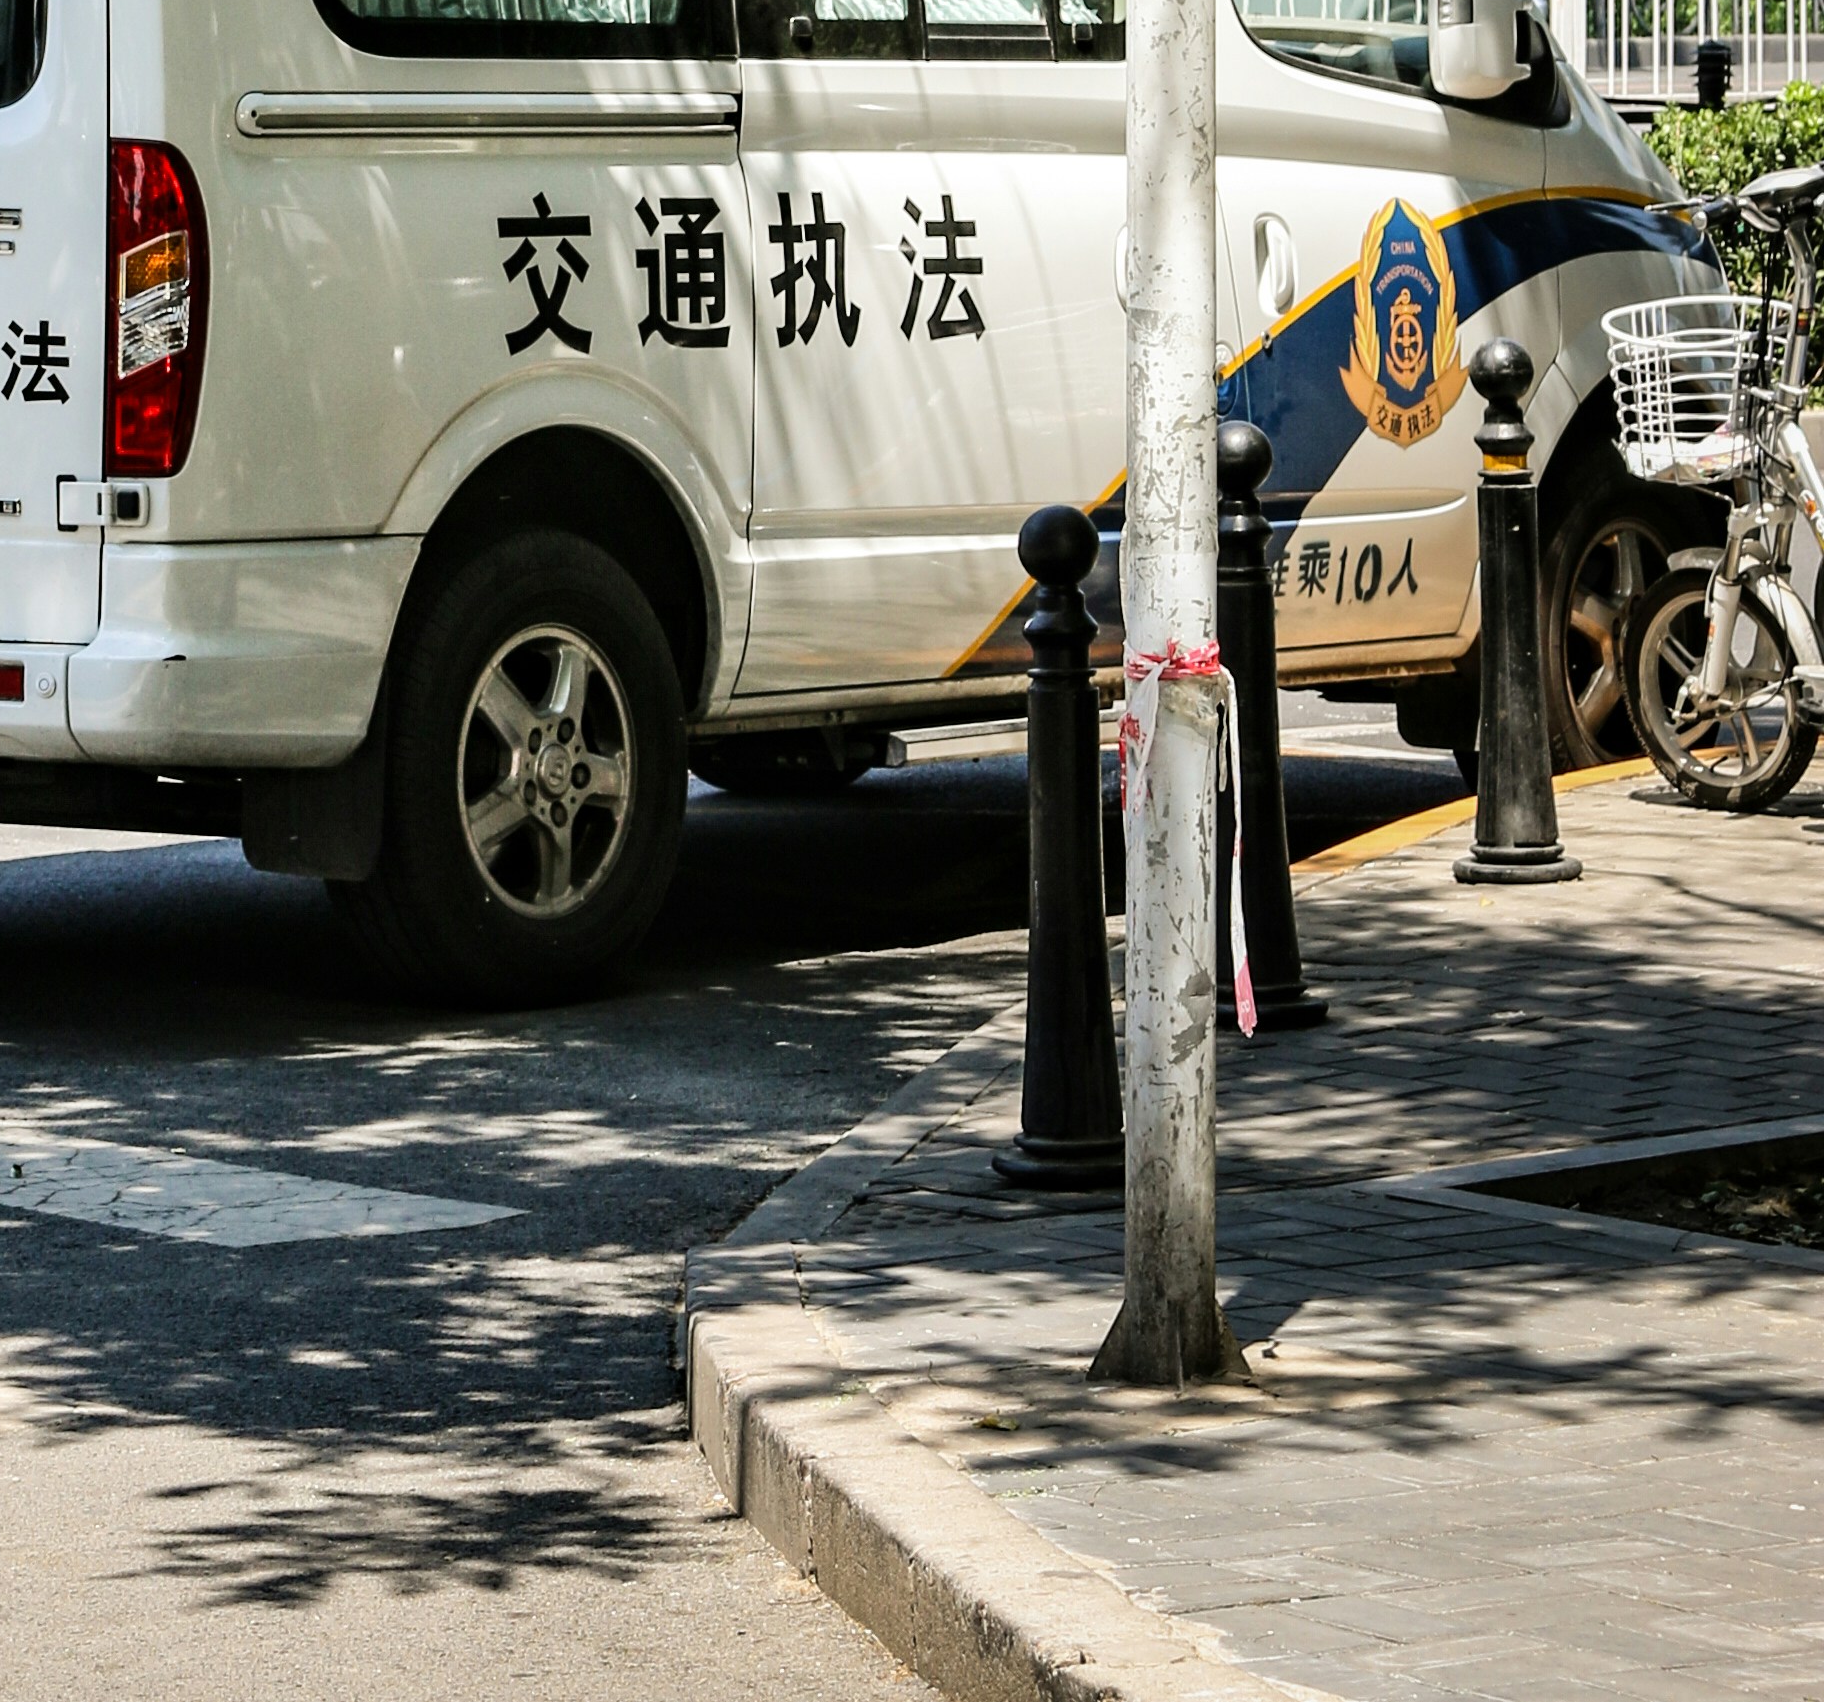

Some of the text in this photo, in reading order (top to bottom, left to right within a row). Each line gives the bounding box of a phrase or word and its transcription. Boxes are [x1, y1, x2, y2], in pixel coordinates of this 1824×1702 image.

[1390, 240, 1416, 255] CHINA
[497, 191, 986, 357] 交通执法
[1376, 263, 1434, 296] TRANSPORTATION
[1375, 403, 1436, 439] 交通执法
